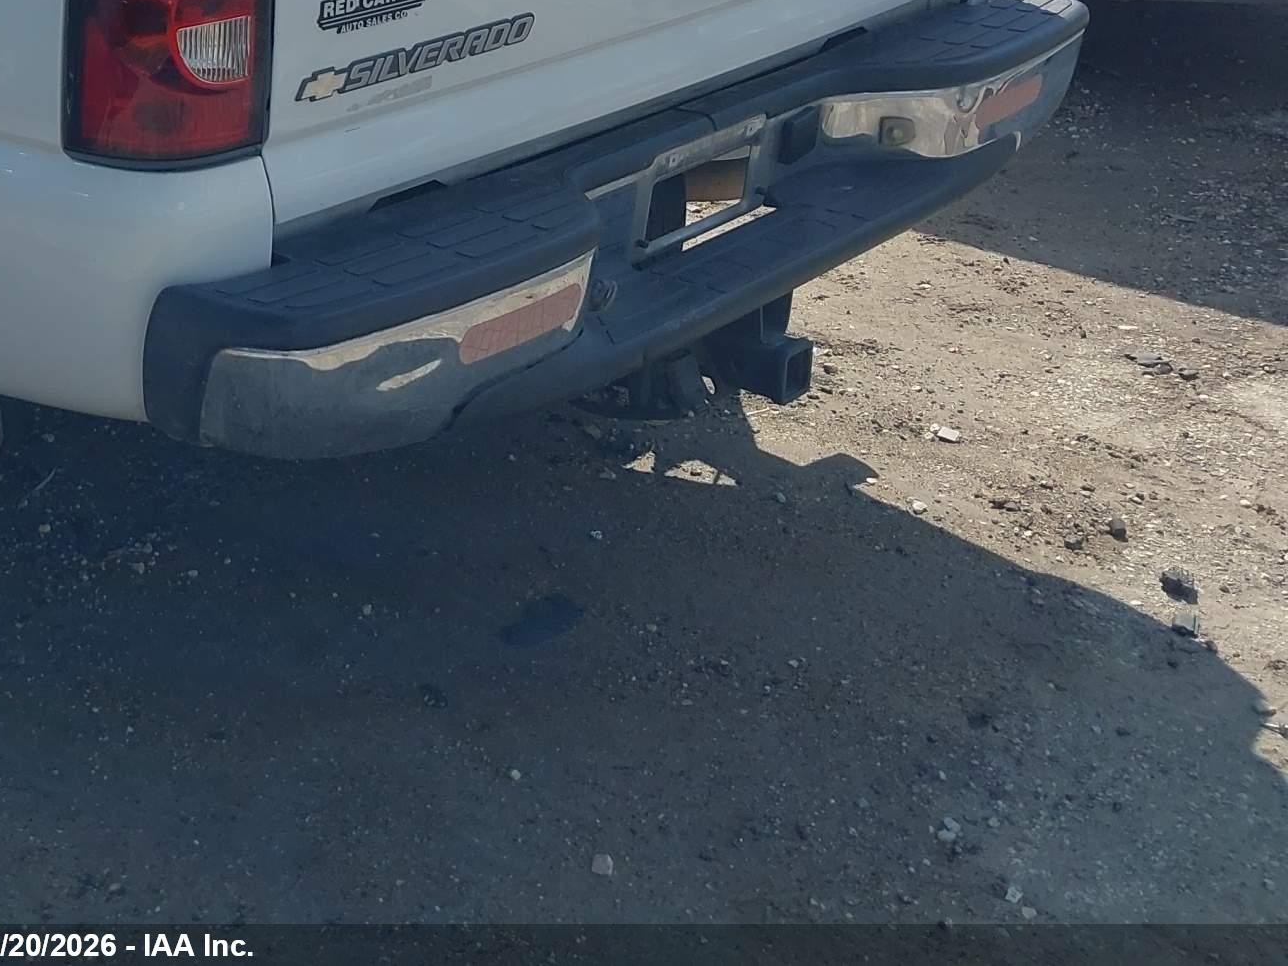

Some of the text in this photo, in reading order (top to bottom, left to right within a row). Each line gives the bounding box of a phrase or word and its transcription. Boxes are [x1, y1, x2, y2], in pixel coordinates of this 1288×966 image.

[338, 19, 365, 34] AUTO
[365, 13, 393, 28] SALES
[341, 13, 535, 93] SILVERADO
